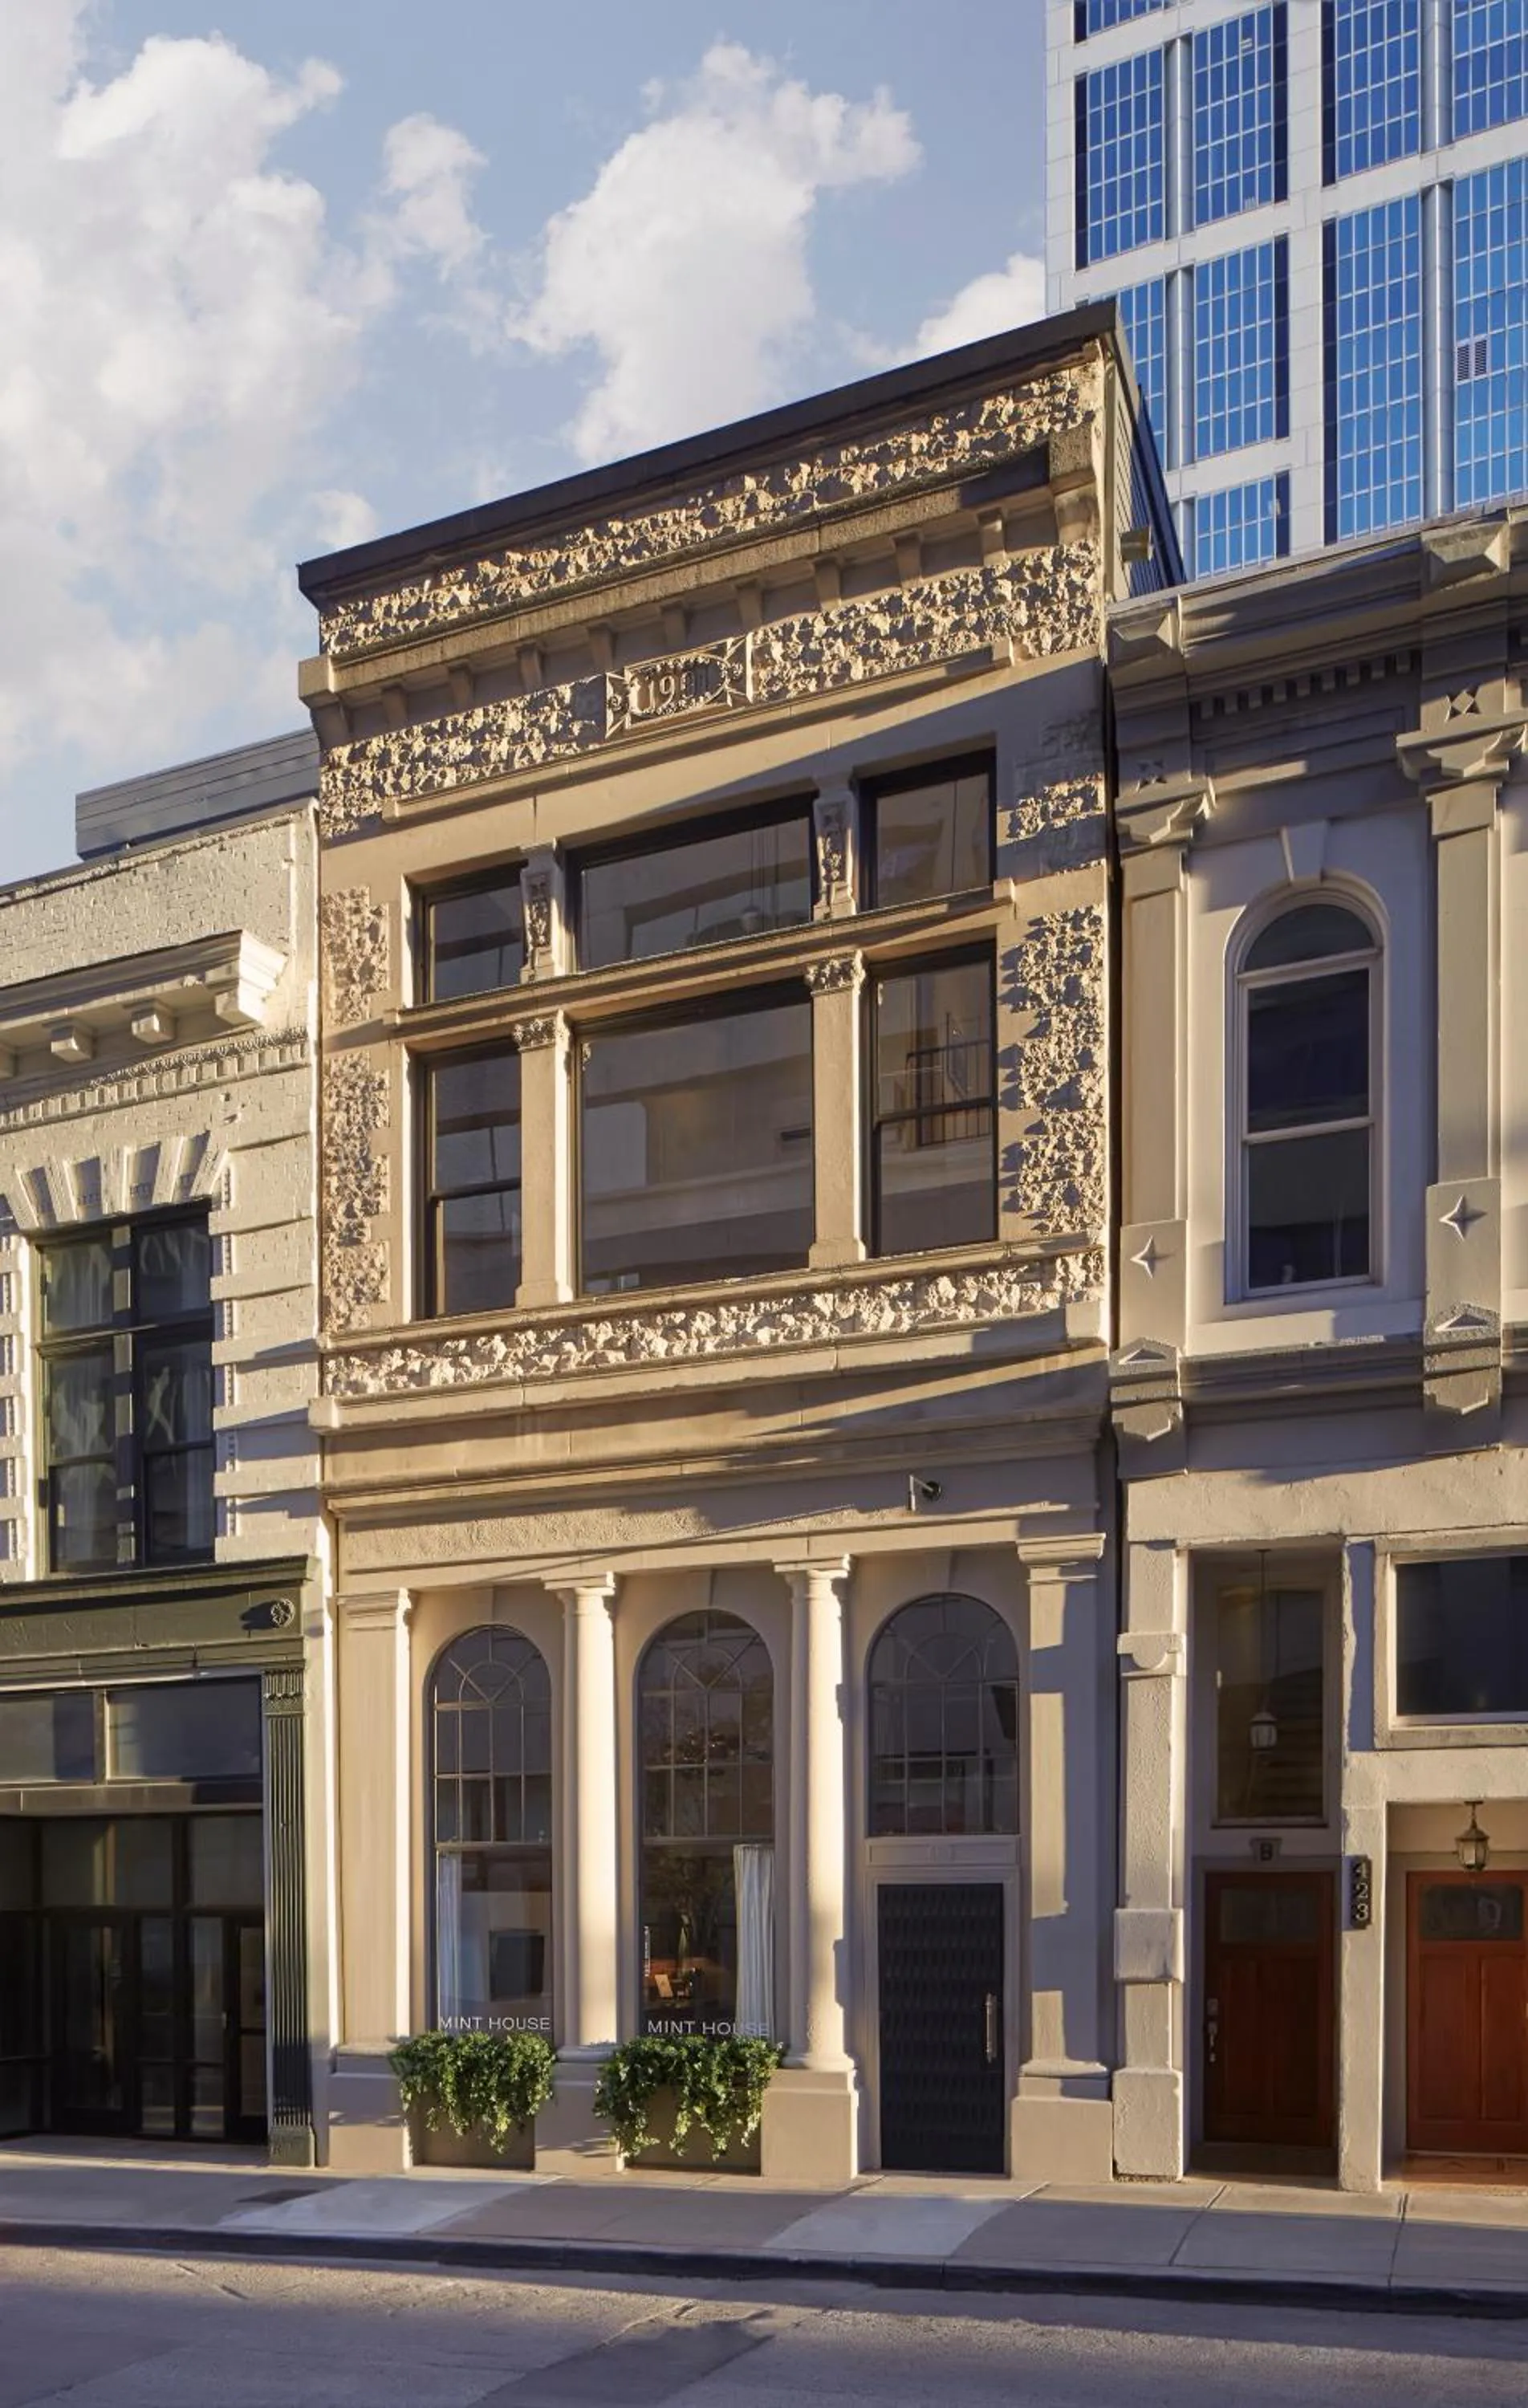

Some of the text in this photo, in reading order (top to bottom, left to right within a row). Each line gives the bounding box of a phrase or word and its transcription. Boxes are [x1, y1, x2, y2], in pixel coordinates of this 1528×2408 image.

[1355, 1862, 1368, 1920] 423
[440, 2016, 551, 2030] MINT HOUSE
[647, 2020, 770, 2036] MINT HOUSE
